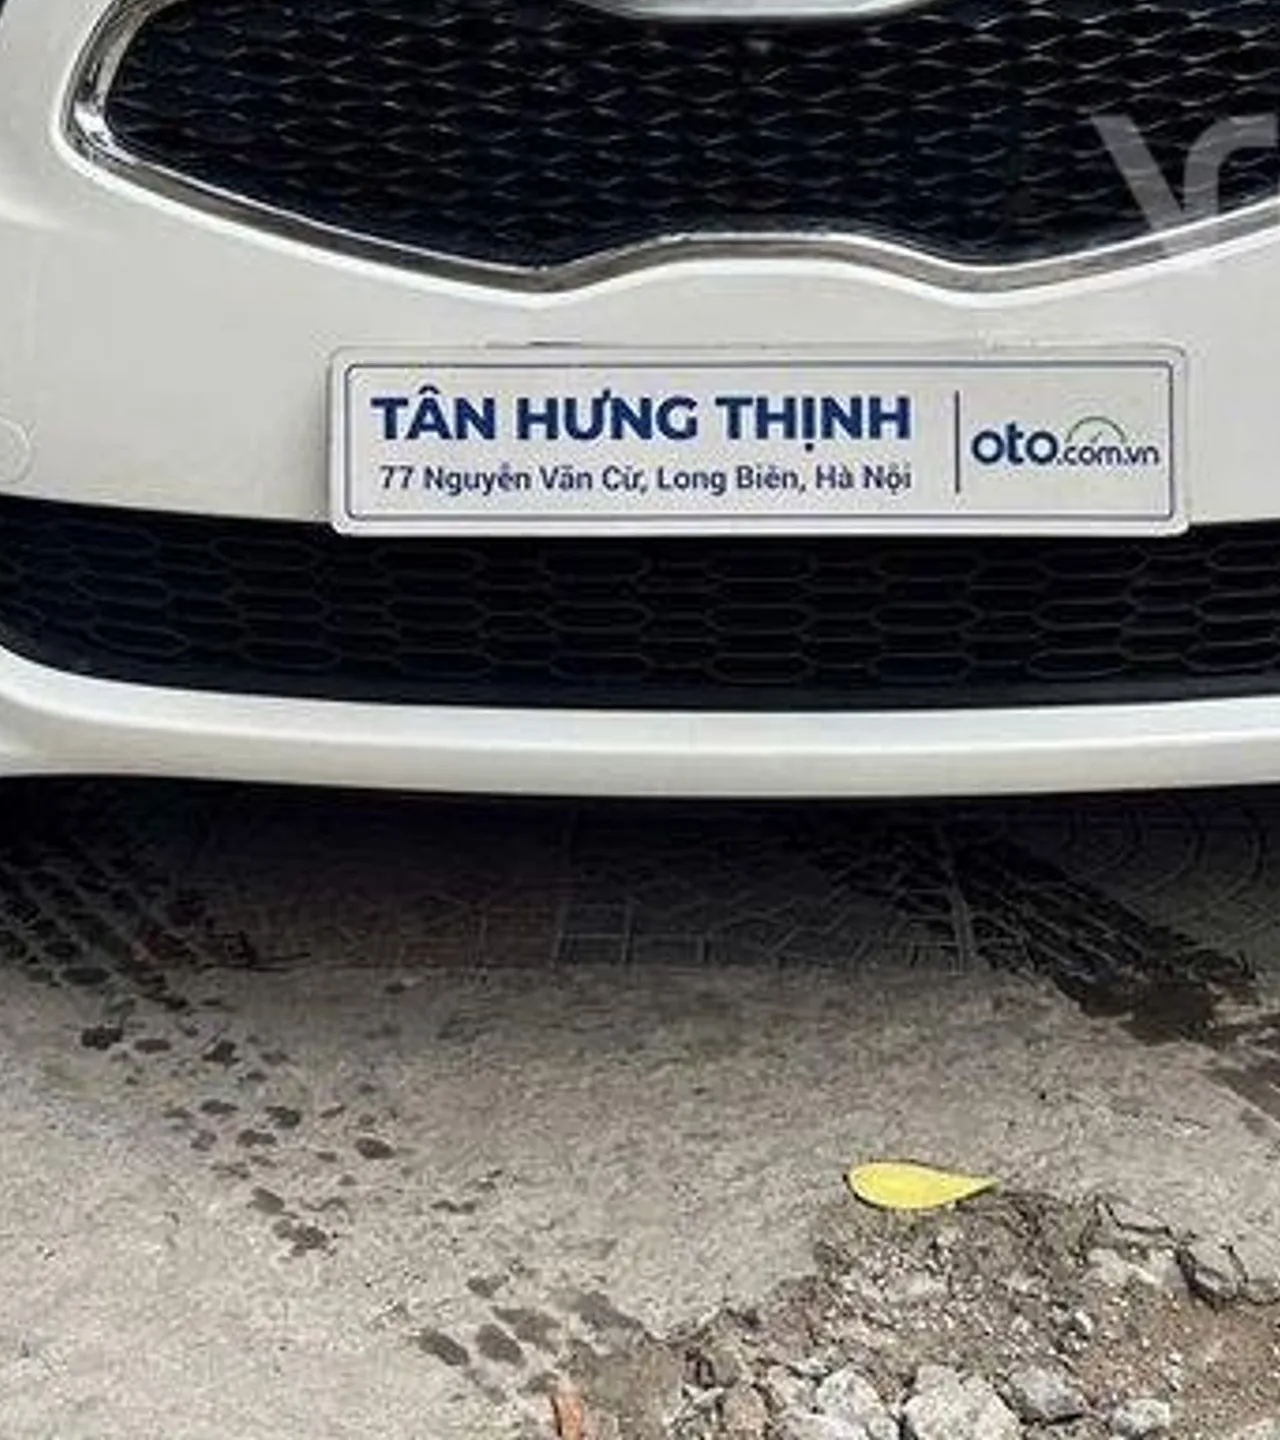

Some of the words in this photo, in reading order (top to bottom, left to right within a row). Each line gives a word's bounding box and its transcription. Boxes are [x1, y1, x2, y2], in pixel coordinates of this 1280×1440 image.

[371, 385, 496, 441] TÂN
[517, 387, 698, 441] HƯNG
[715, 396, 911, 452] THỊNH
[380, 465, 414, 490] 77
[657, 466, 727, 496] Long
[736, 464, 806, 492] Biên,
[815, 464, 854, 490] Hà
[863, 462, 912, 495] Nội
